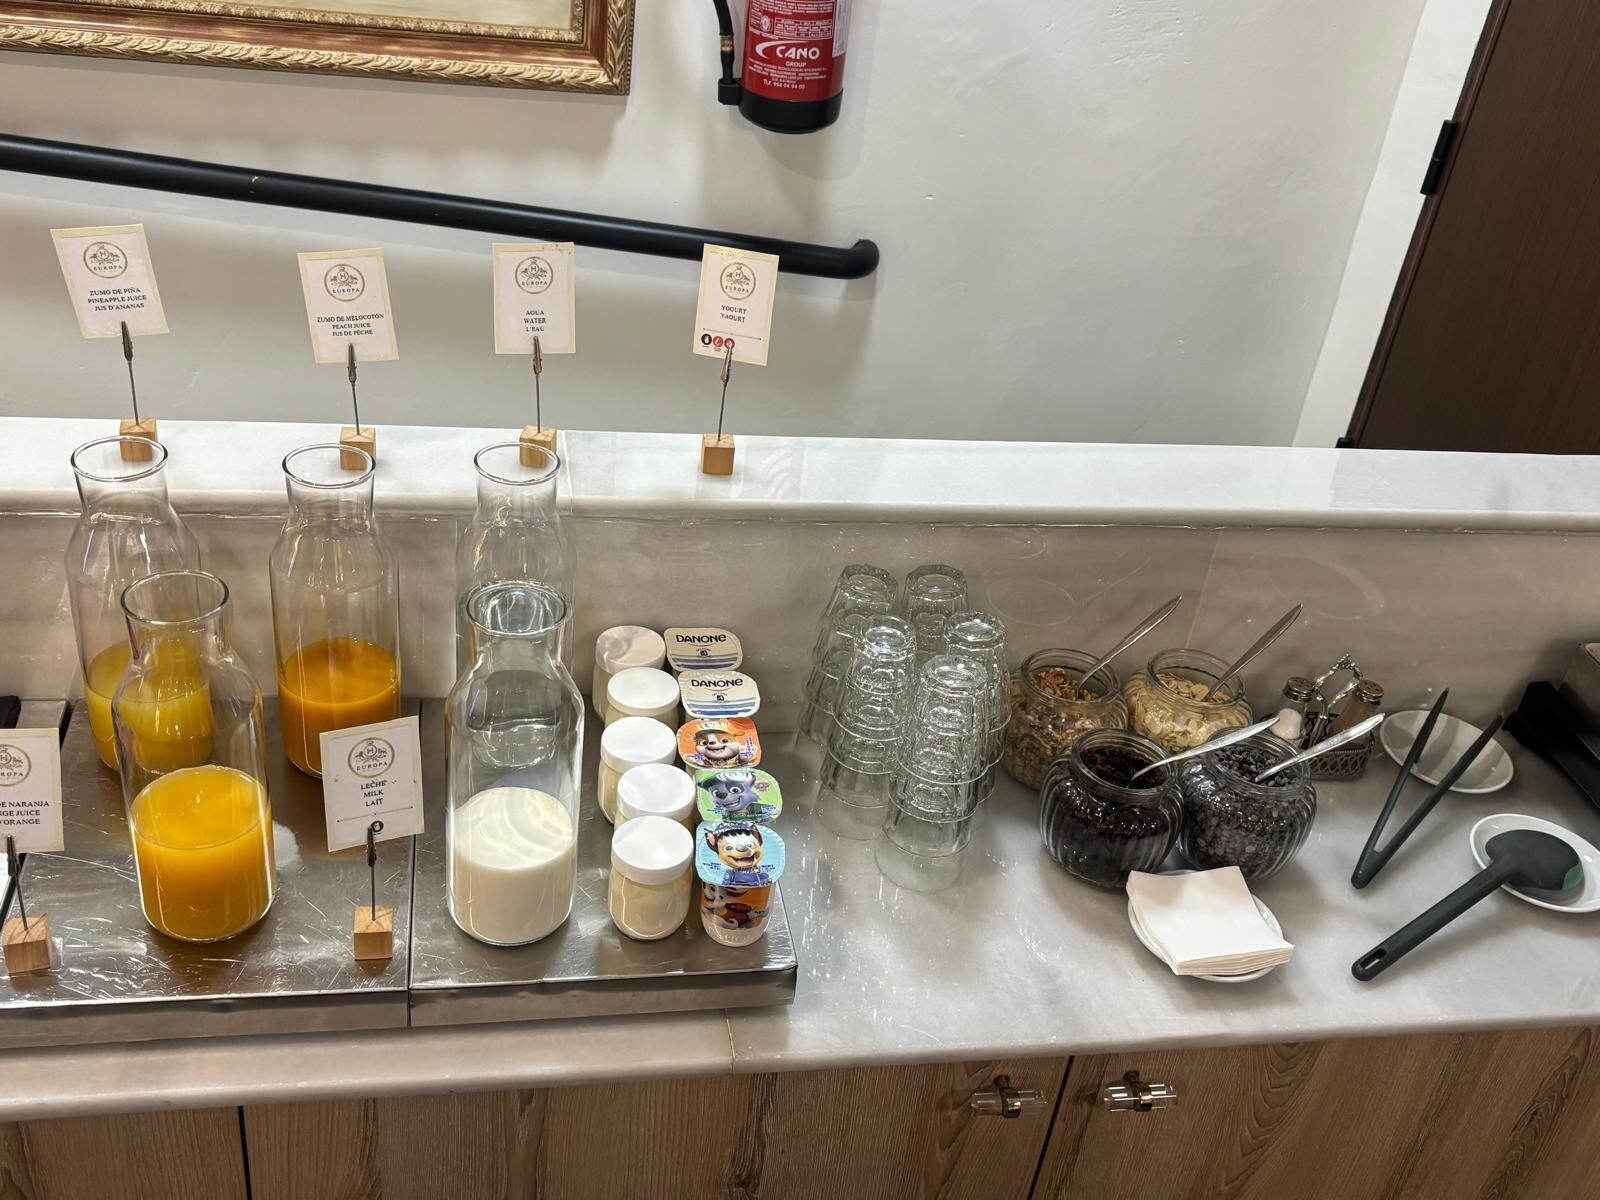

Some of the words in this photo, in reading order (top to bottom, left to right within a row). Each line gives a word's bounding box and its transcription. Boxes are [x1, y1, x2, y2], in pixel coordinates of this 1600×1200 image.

[776, 45, 820, 60] CANO
[725, 285, 750, 293] EUROPA
[88, 296, 126, 304] PINEAPPLE
[127, 294, 147, 302] JUICE
[721, 304, 747, 315] YOGURT
[720, 312, 746, 323] YAOURT
[676, 634, 727, 643] DANONE
[691, 678, 744, 688] DANONE
[356, 762, 388, 770] EUROPA
[360, 780, 387, 790] LECHE
[364, 790, 384, 798] MILK
[366, 798, 384, 806] LAIT
